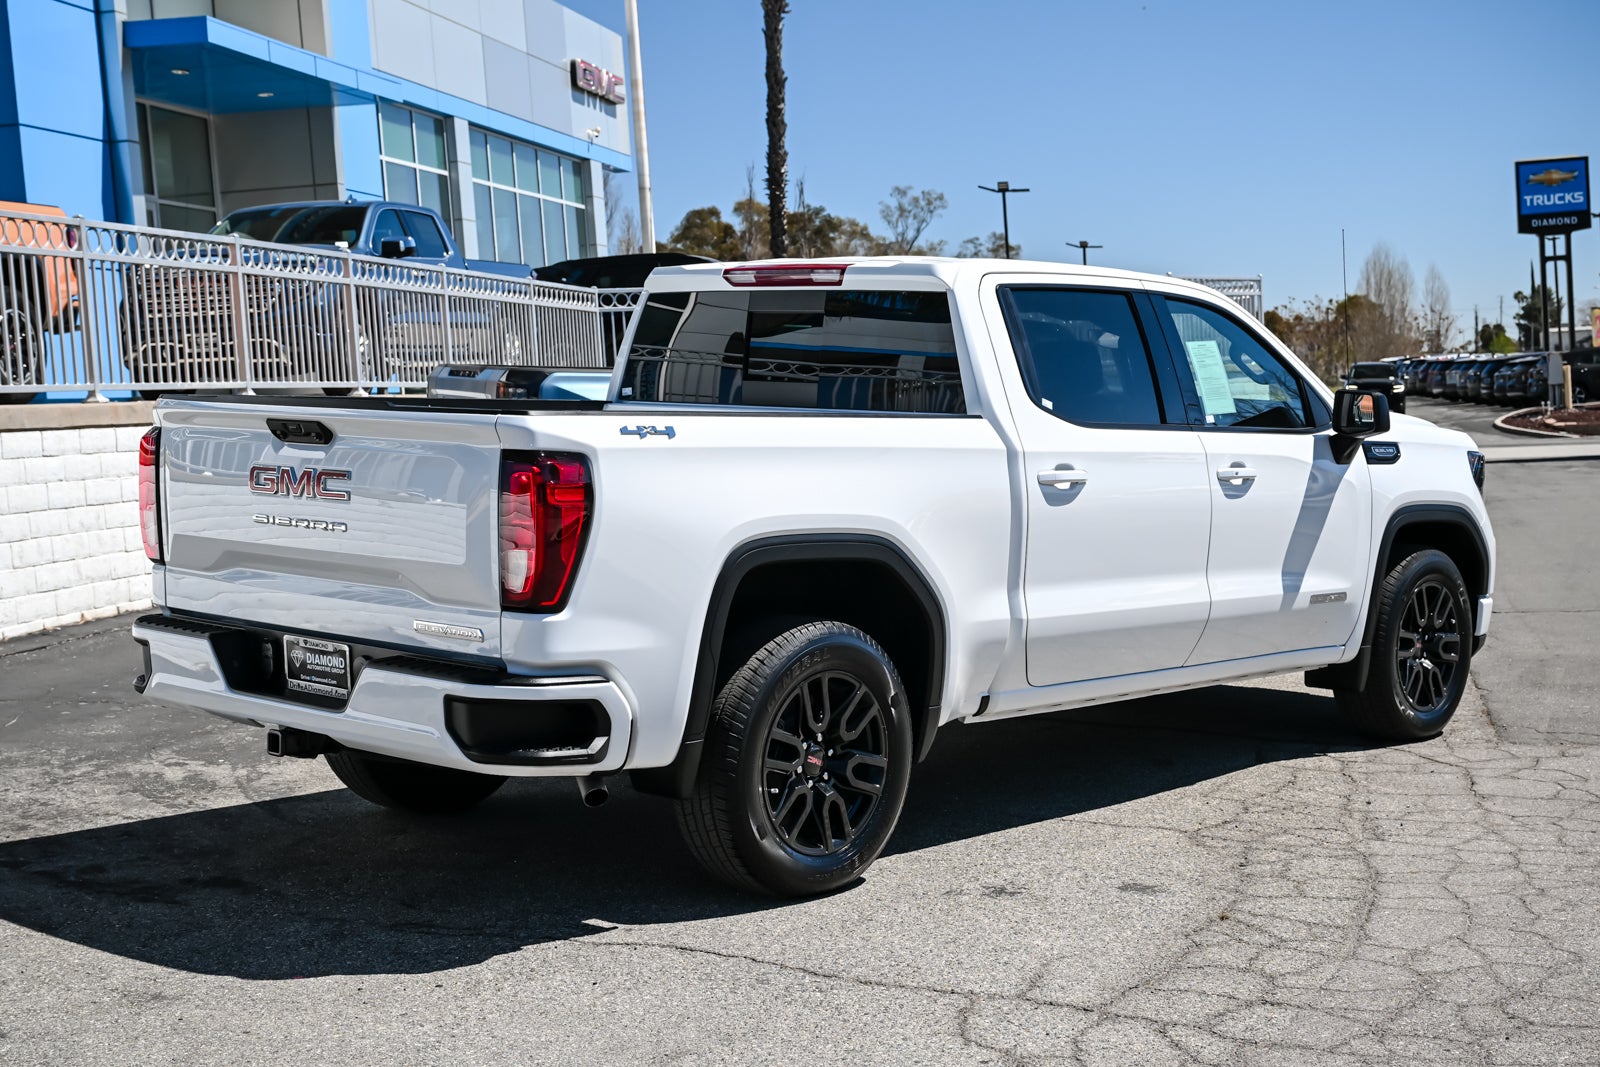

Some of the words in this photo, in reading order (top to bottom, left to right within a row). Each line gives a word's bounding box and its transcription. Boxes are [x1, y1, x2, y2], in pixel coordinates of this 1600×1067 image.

[572, 58, 625, 104] GMC
[1523, 191, 1584, 207] TRUCKS
[1531, 216, 1578, 227] DIAMOND
[249, 464, 352, 501] GMC
[252, 513, 348, 533] SIERRA
[418, 624, 477, 637] ELEVATION
[306, 652, 345, 668] DIAMOND
[307, 664, 331, 672] AUTOMOTIVE
